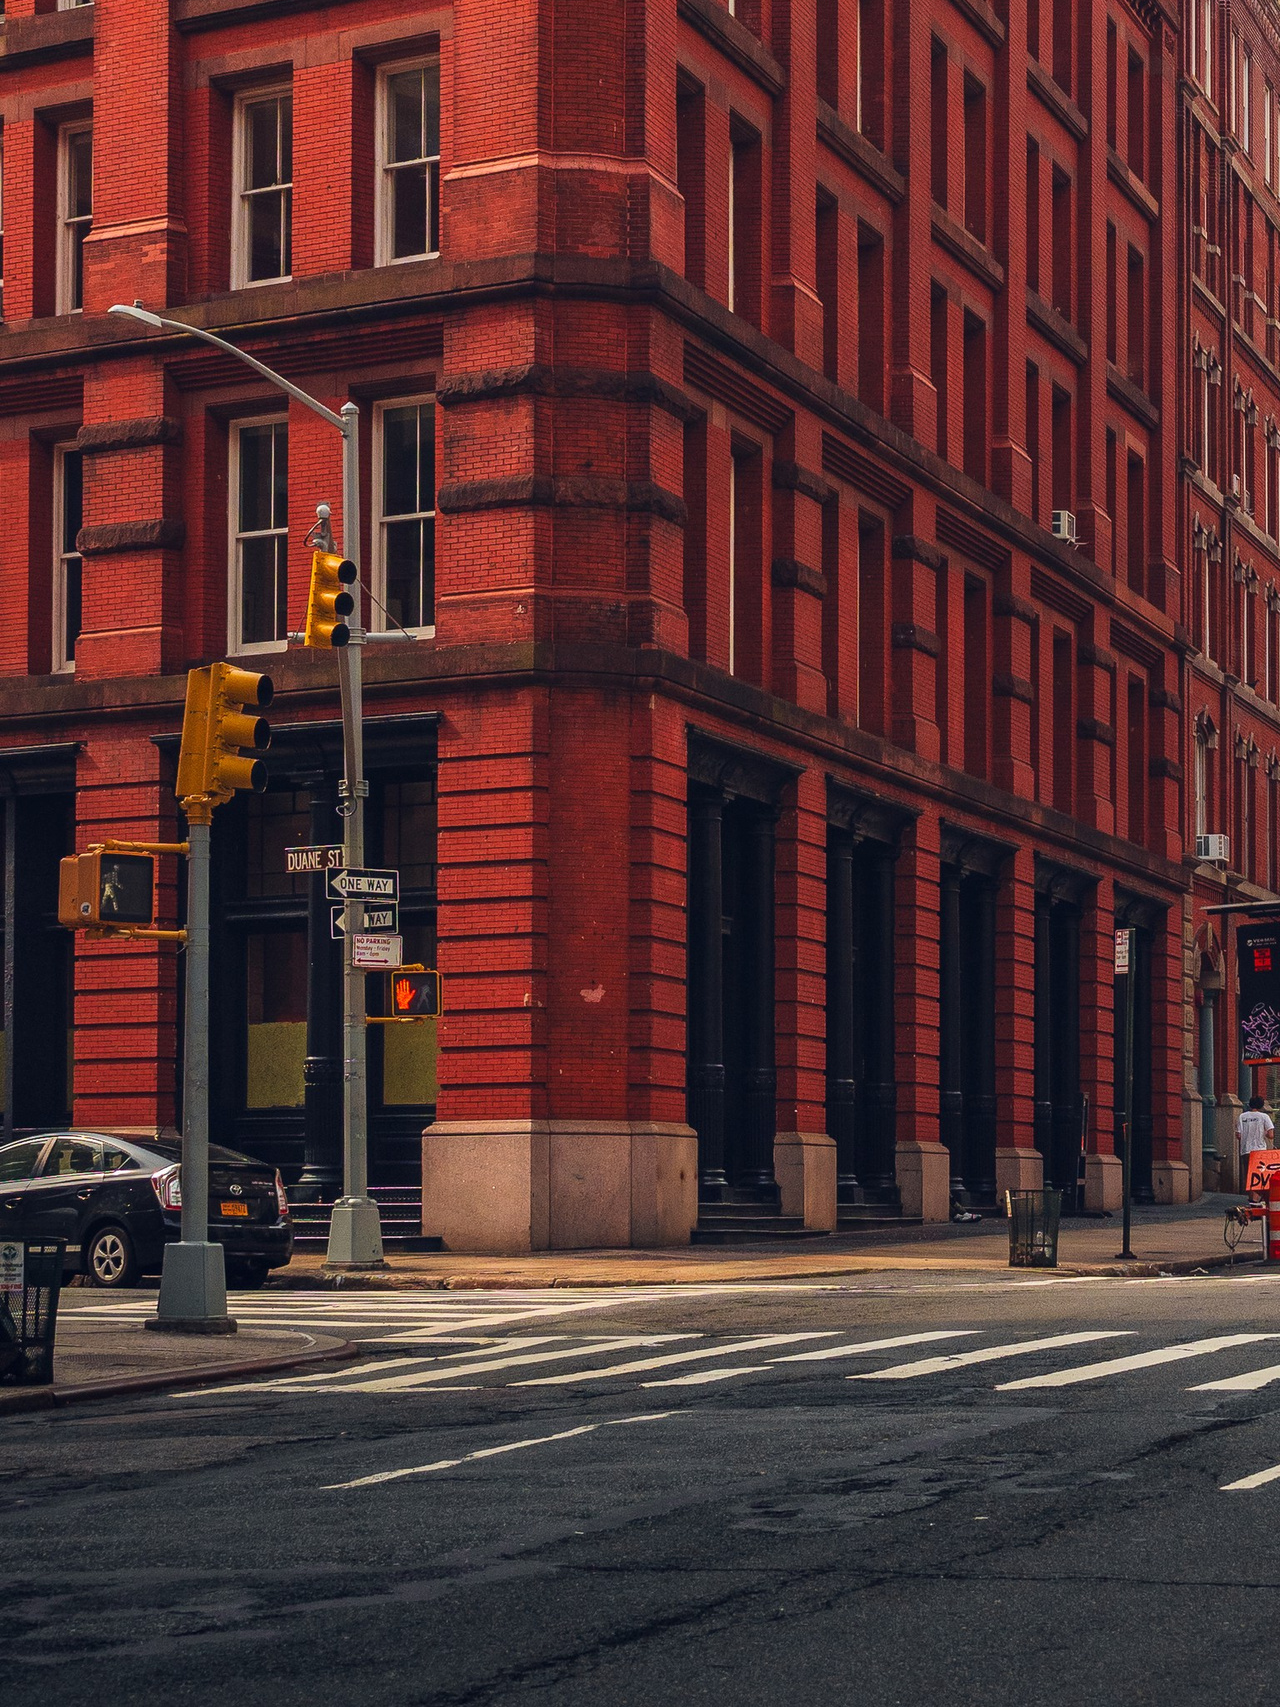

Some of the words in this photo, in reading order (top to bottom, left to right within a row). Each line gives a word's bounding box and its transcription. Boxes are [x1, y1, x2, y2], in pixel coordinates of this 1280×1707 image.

[288, 851, 322, 871] DUANE
[327, 850, 341, 867] ST
[340, 878, 362, 889] ONE
[367, 878, 388, 891] WAY
